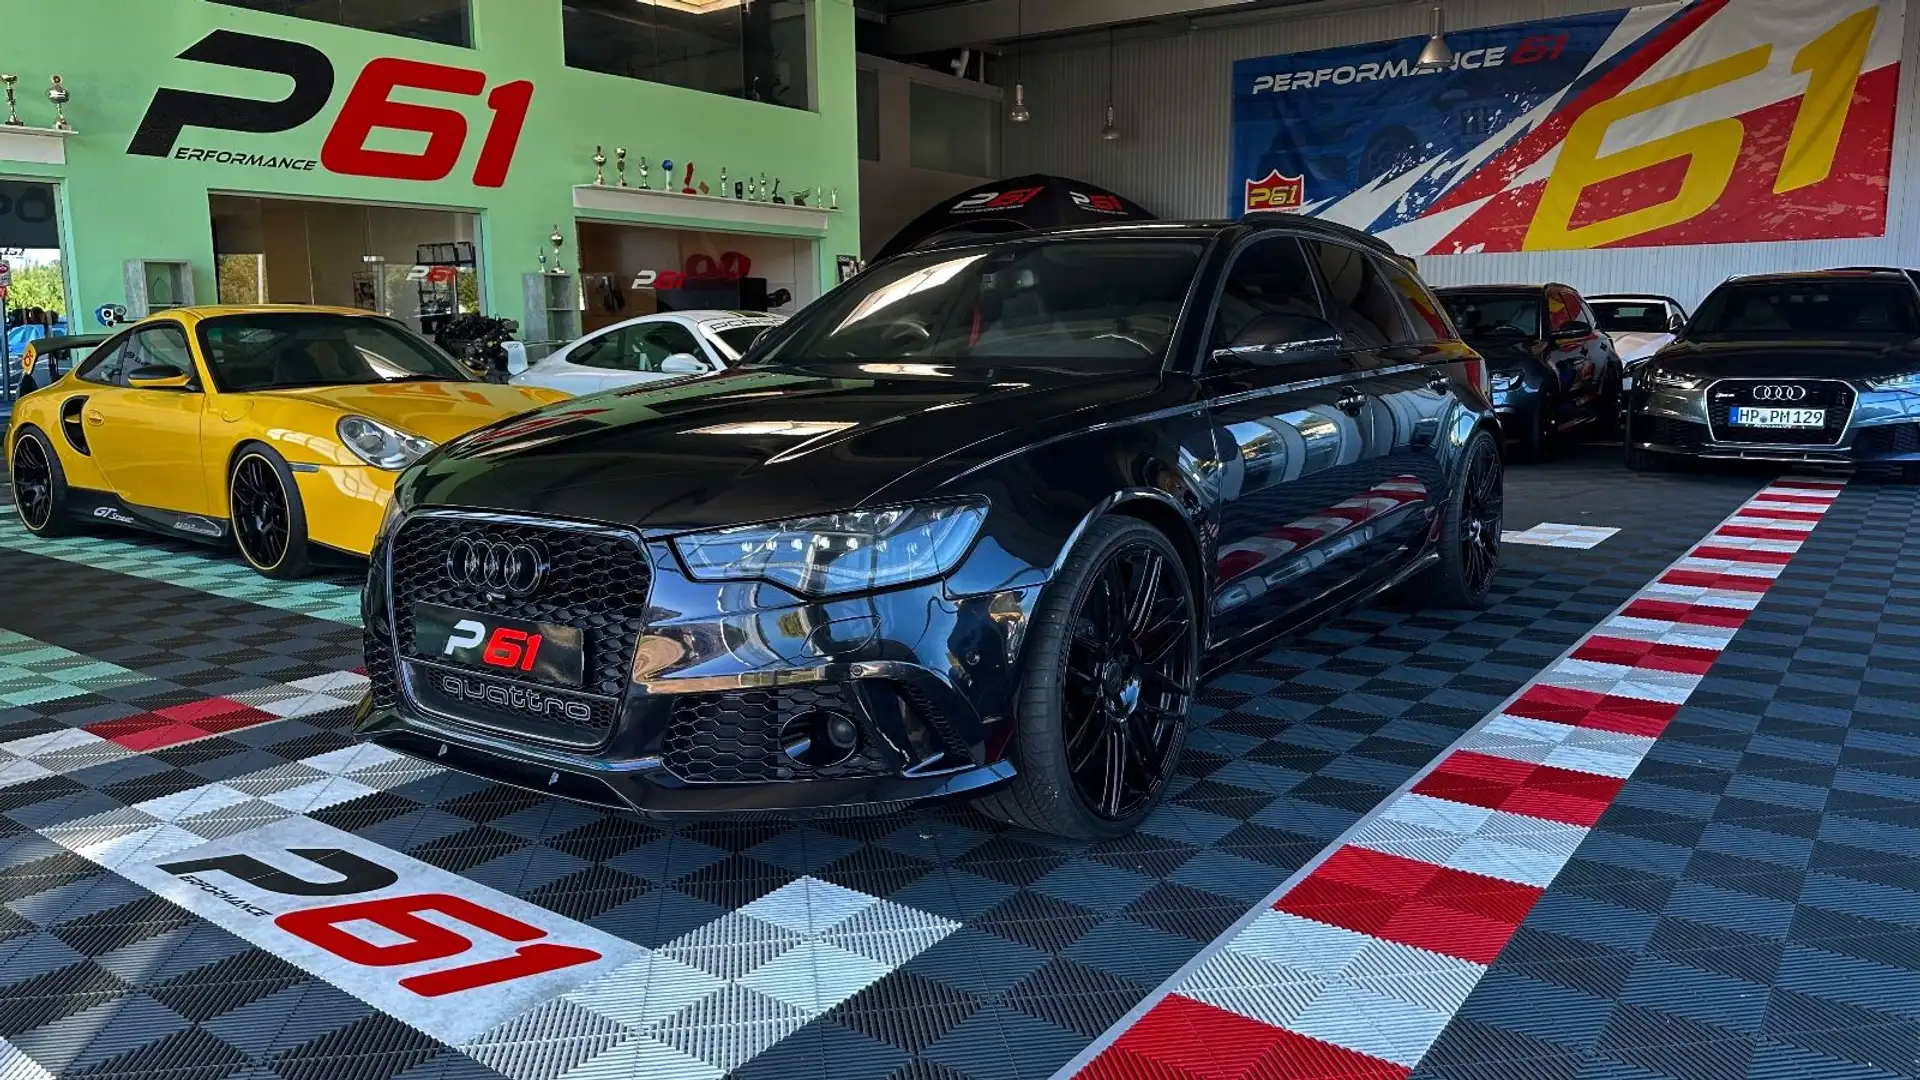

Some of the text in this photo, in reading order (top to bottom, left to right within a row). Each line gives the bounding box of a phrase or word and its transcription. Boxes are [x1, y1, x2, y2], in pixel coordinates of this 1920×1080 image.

[1252, 33, 1569, 95] PERFORMNCE 61
[126, 29, 534, 188] P61
[1522, 6, 1880, 251] 61
[952, 186, 1044, 209] P61
[1069, 191, 1123, 210] P61
[1249, 184, 1299, 206] P61
[631, 269, 686, 290] P61
[1739, 409, 1823, 424] HP PM 129
[93, 506, 118, 518] GT
[444, 619, 543, 671] P61
[442, 676, 592, 722] quattro
[157, 848, 603, 998] P61
